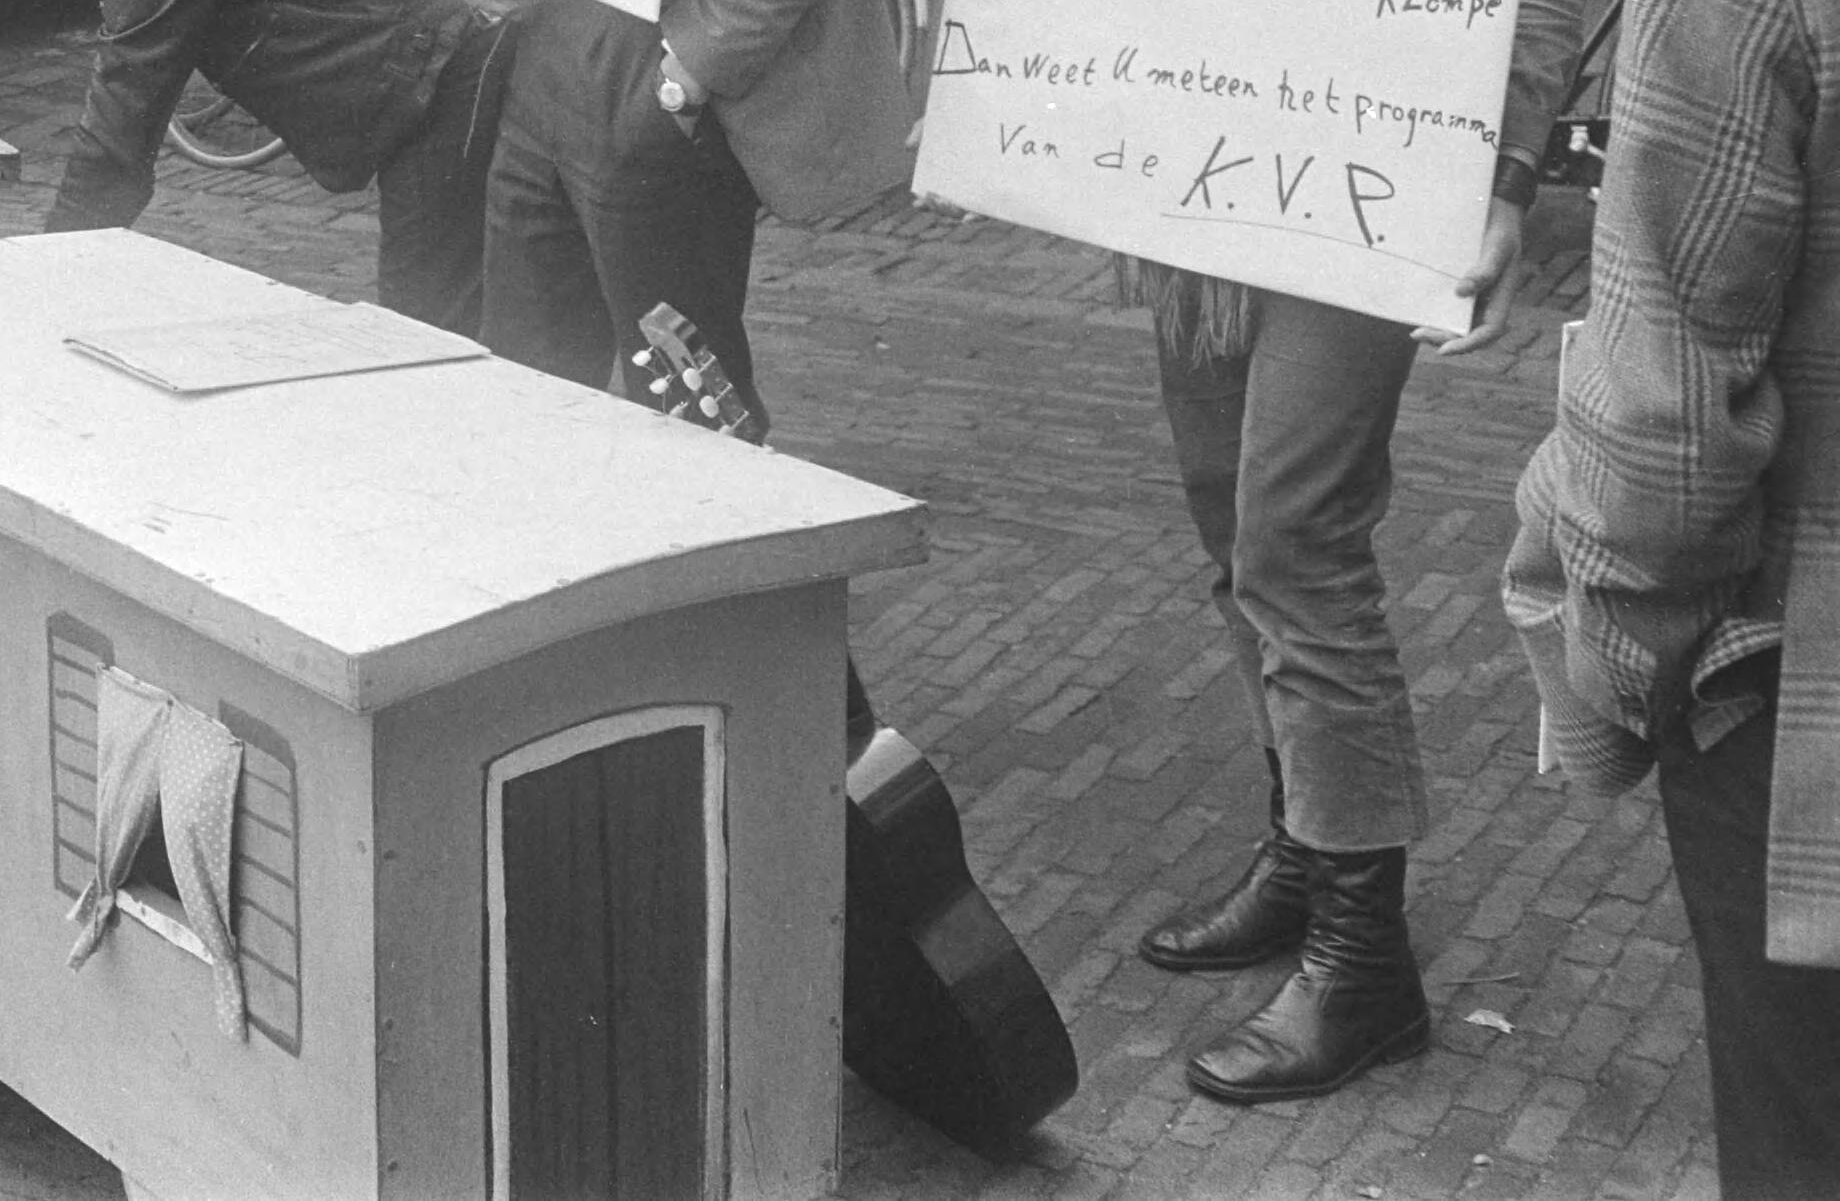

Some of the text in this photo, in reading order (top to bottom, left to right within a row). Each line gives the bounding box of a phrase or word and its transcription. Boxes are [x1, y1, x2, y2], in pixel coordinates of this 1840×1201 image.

[931, 19, 1012, 75] Dan
[1147, 59, 1259, 98] meteen
[1277, 69, 1340, 114] het
[1094, 139, 1158, 177] de
